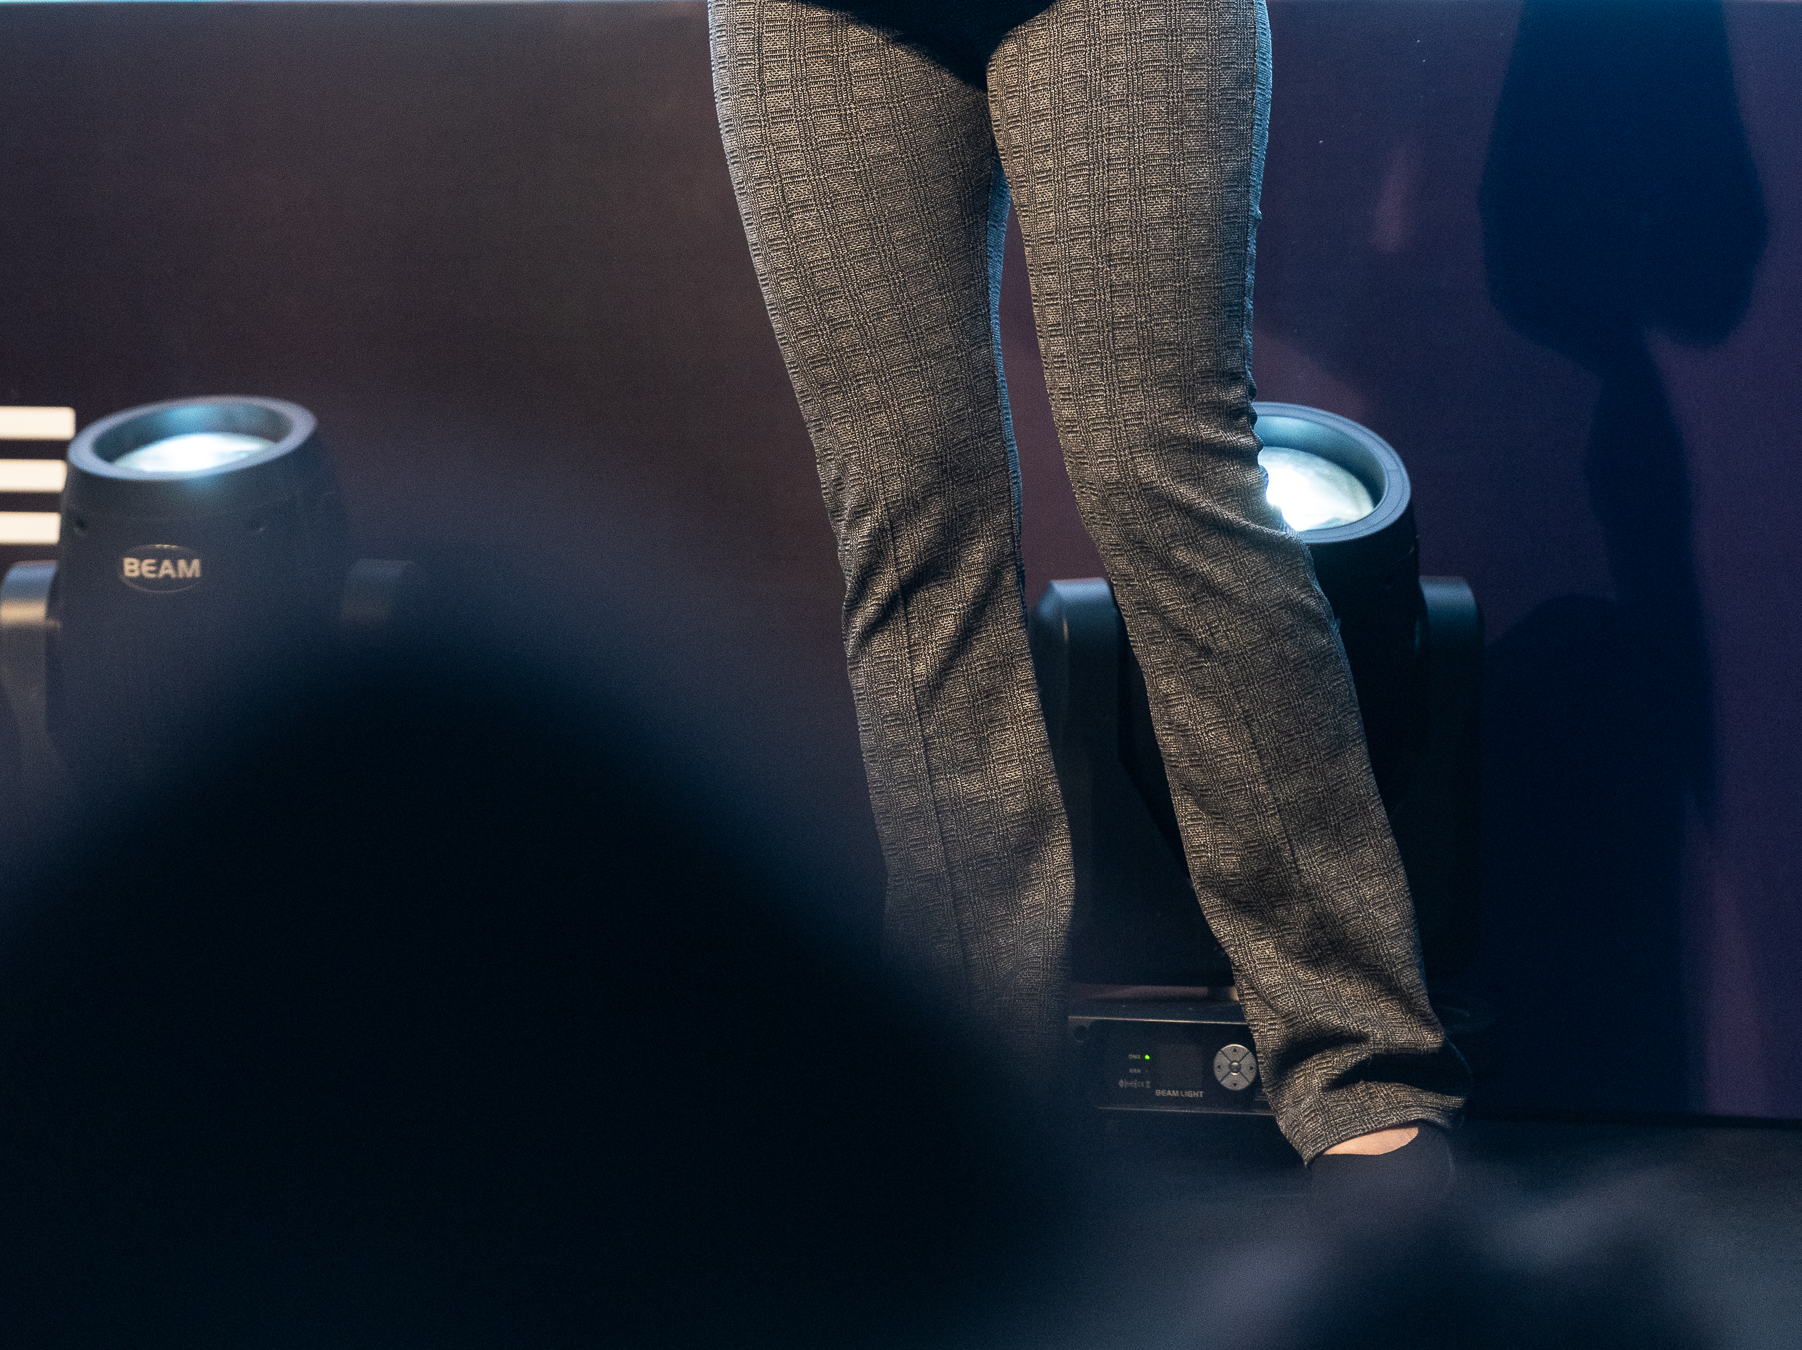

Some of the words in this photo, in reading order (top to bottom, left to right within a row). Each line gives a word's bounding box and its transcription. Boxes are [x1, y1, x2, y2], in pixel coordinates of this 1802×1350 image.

[122, 556, 201, 579] BEAM
[1155, 1089, 1179, 1097] BEAM
[1180, 1090, 1204, 1098] LIGHT
